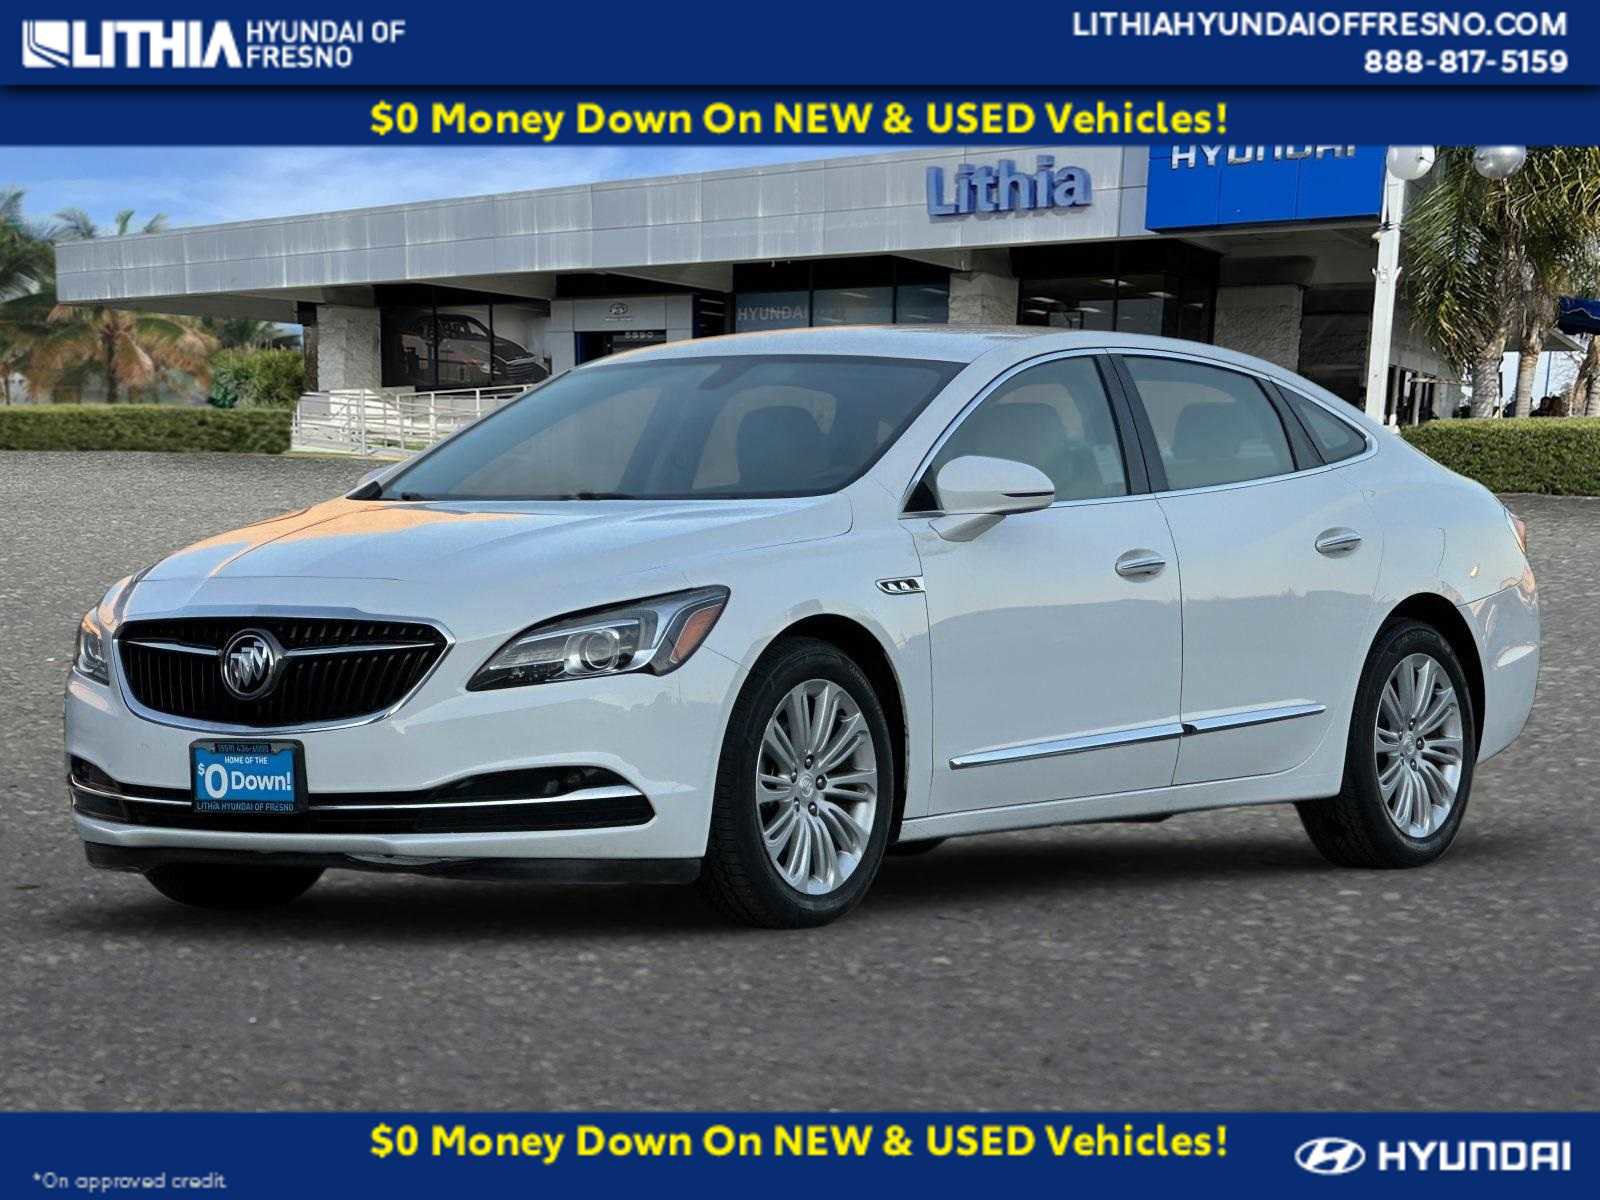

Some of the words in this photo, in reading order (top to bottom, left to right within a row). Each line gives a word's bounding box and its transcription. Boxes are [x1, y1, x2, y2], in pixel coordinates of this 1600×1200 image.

[926, 155, 1092, 215] Lithia
[738, 305, 808, 320] HYUNDAI
[224, 755, 244, 764] HOME
[245, 755, 254, 764] OF
[254, 755, 268, 765] THE
[231, 771, 292, 791] Down!
[221, 802, 252, 811] HYUNDAI
[254, 802, 264, 812] OF
[265, 802, 294, 812] FRESNO
